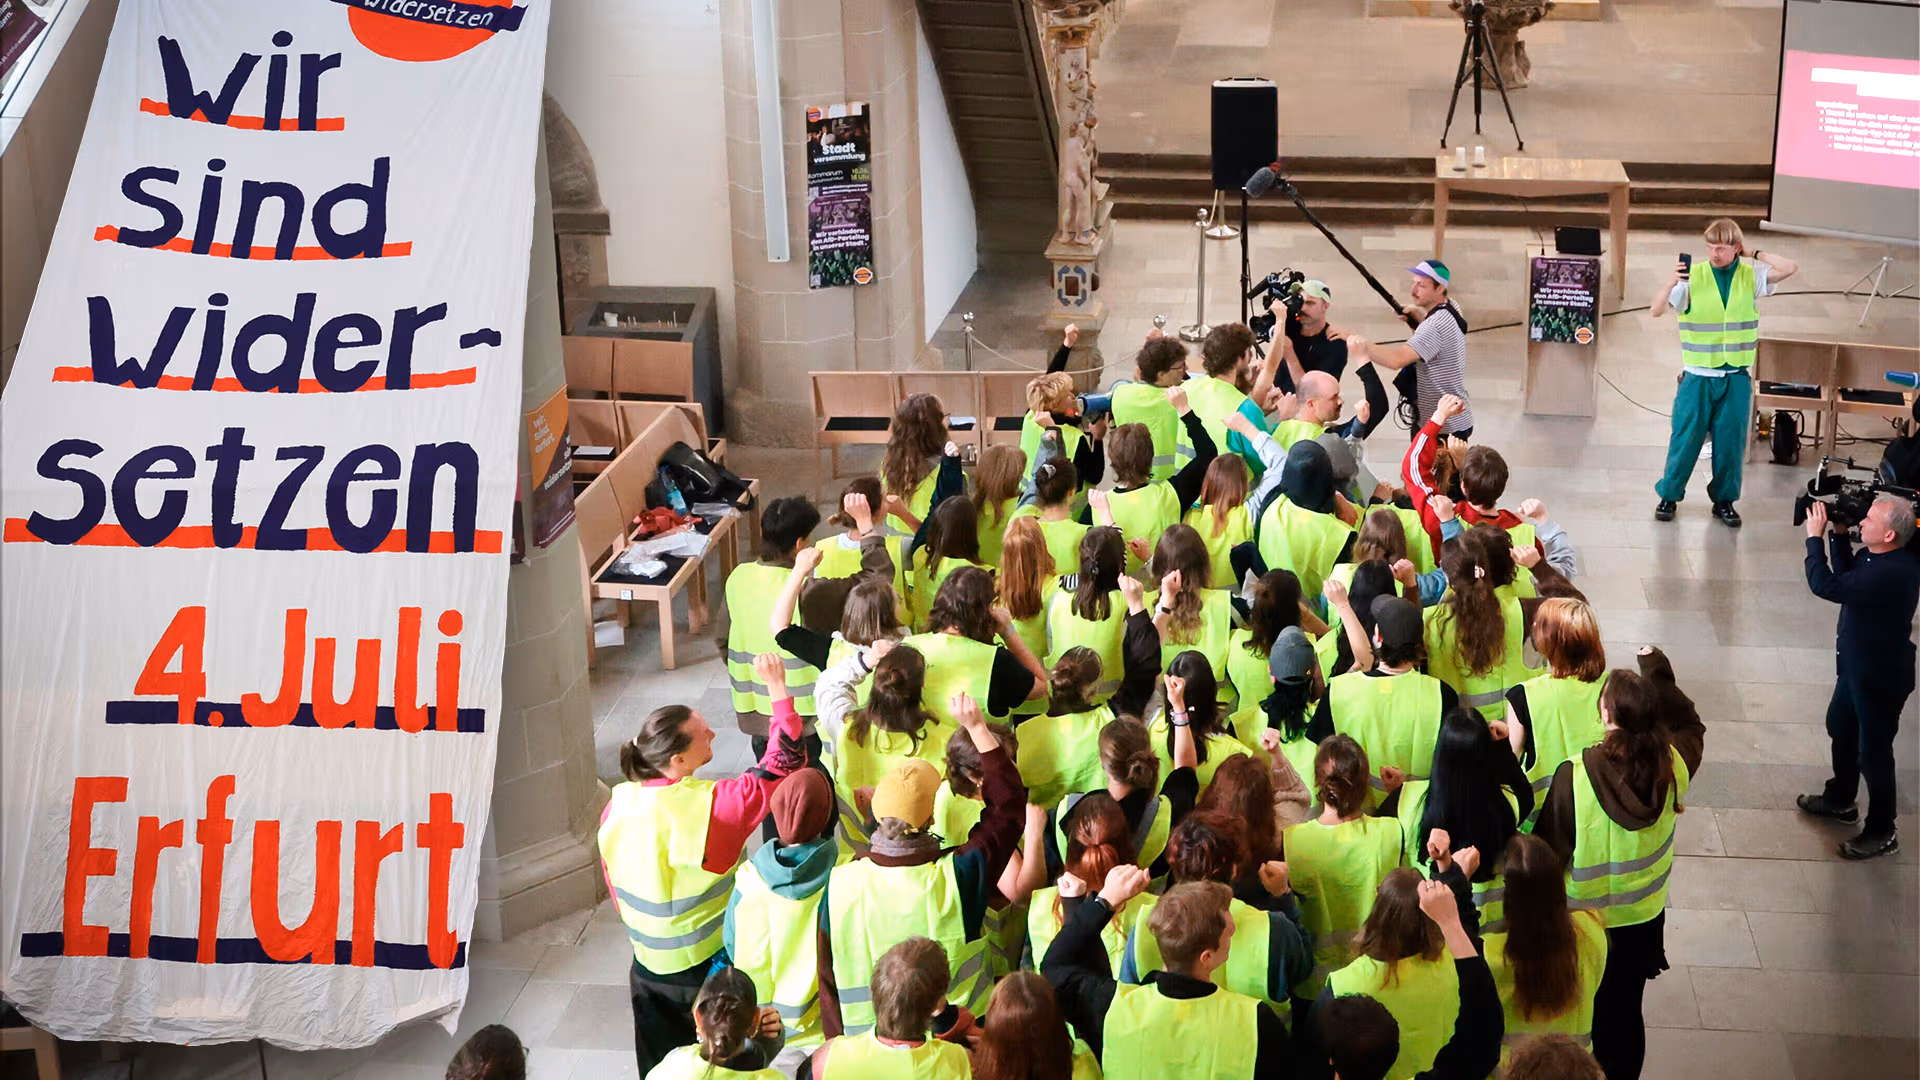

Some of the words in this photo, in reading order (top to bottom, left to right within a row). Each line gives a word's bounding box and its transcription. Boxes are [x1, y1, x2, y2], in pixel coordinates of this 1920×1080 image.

[814, 153, 866, 164] versammlung
[822, 142, 856, 155] Stadt
[117, 157, 391, 260] sind
[815, 230, 828, 238] Wir
[26, 428, 480, 553] setzen
[65, 775, 465, 969] Erfurt
